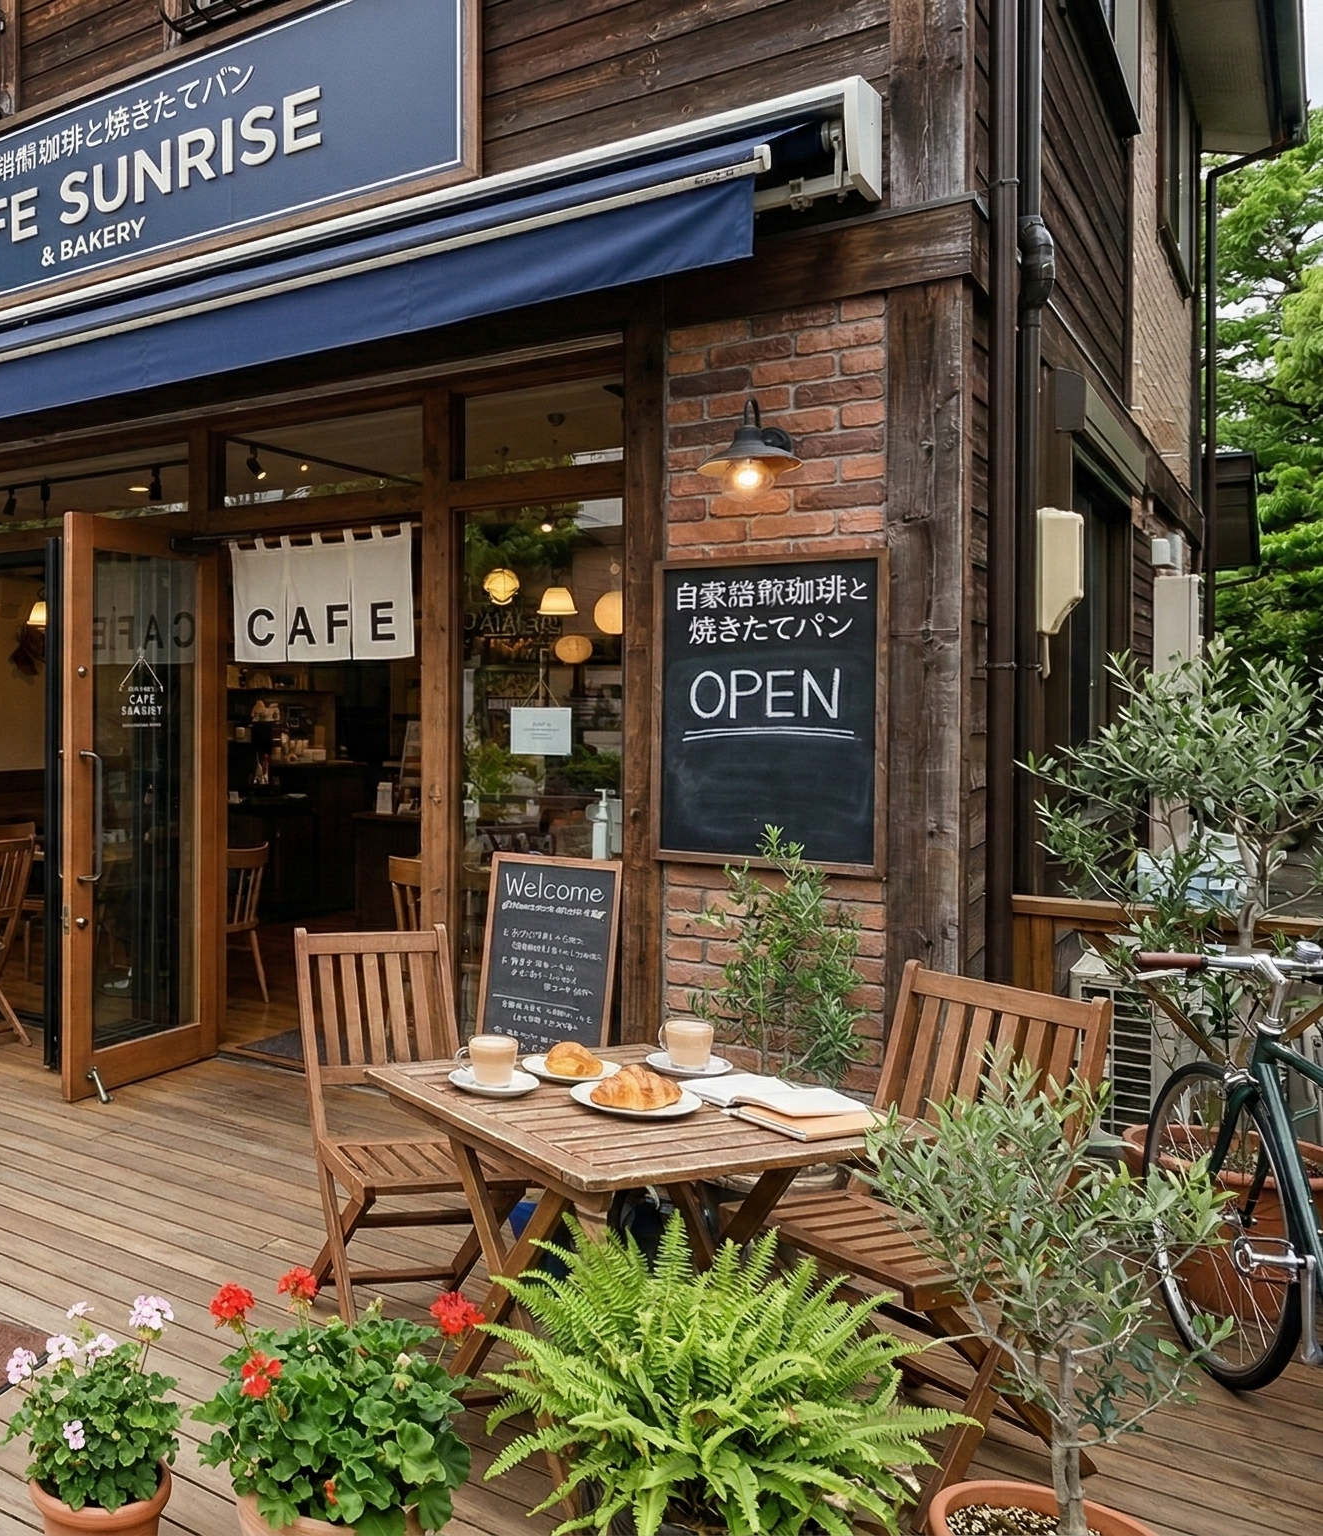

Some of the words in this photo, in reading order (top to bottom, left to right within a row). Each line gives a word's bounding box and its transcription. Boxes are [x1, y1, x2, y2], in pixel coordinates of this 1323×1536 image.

[59, 85, 323, 225] SUNRISE
[41, 246, 56, 267] &
[60, 216, 146, 261] BAKERY
[247, 601, 396, 647] CAFE
[688, 612, 853, 645] 焼きたてパン
[689, 667, 841, 719] OPEN
[505, 871, 605, 903] Welcome
